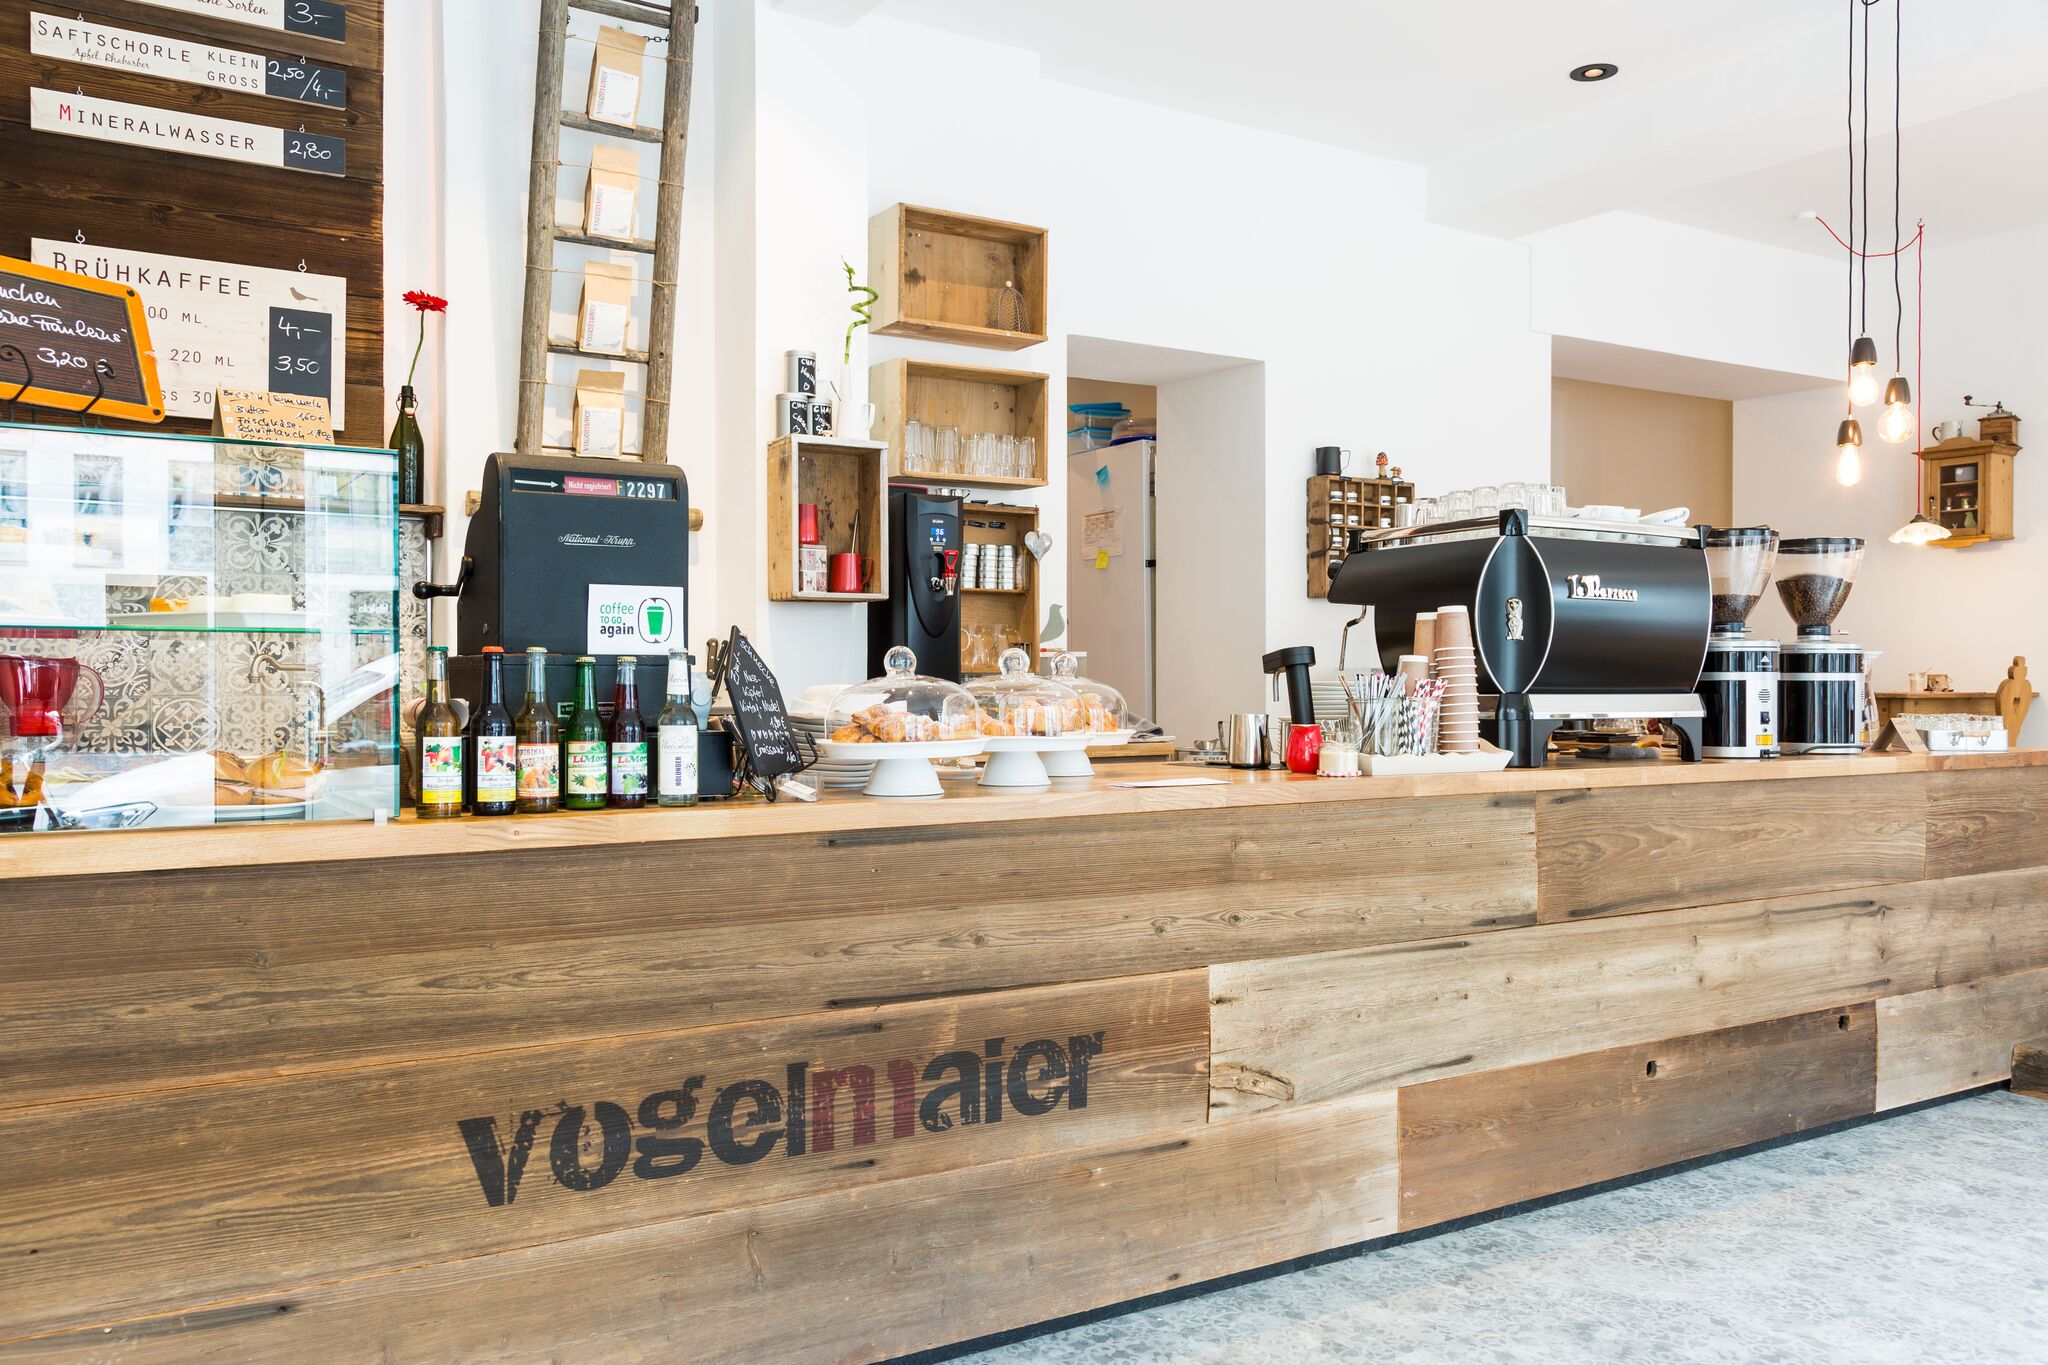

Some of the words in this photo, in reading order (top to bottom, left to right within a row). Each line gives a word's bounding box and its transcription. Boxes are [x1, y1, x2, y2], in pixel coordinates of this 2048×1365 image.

[38, 20, 191, 63] SAFTSCHORLE
[208, 51, 259, 69] KLEIN
[207, 71, 258, 89] GROSS
[59, 104, 256, 151] MINERALWASSER
[289, 140, 332, 160] 2,80
[53, 252, 251, 298] BRÜHKAFFEE
[181, 312, 202, 324] ML
[36, 347, 88, 368] 3,20
[170, 348, 201, 364] 220
[214, 356, 235, 367] ML
[274, 355, 320, 375] 3,50
[235, 404, 269, 414] Butter
[568, 480, 584, 490] Nicht
[584, 483, 612, 492] registriert
[626, 481, 665, 499] 2297
[935, 528, 945, 536] 96
[600, 602, 634, 615] coffee
[600, 616, 610, 624] TO
[611, 616, 622, 624] GO
[600, 623, 634, 638] again
[457, 1031, 1105, 1207] vogelmaier
